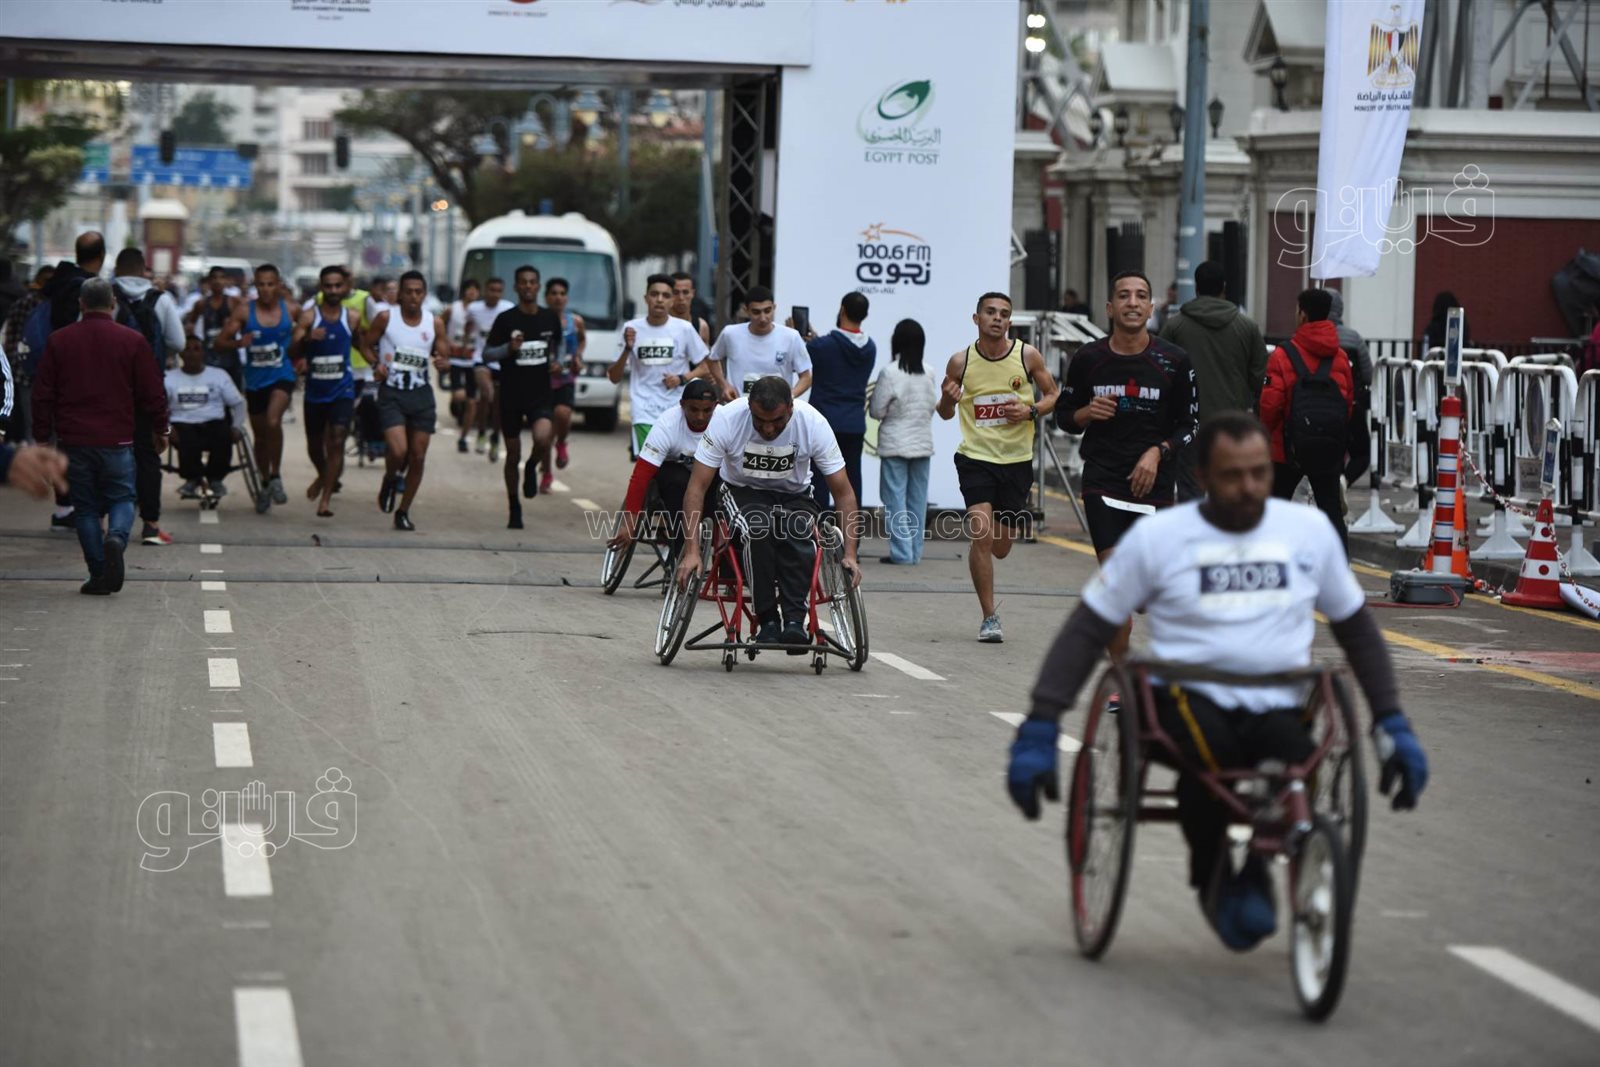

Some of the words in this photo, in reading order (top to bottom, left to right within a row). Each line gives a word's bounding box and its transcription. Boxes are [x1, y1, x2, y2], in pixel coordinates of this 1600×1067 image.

[864, 151, 903, 164] EGYPT
[907, 152, 939, 165] POST
[856, 243, 904, 260] 100.6
[906, 244, 931, 261] FM
[856, 261, 931, 286] نجوم
[640, 346, 670, 358] 5442
[748, 456, 789, 471] 4579
[1208, 563, 1281, 593] 9108
